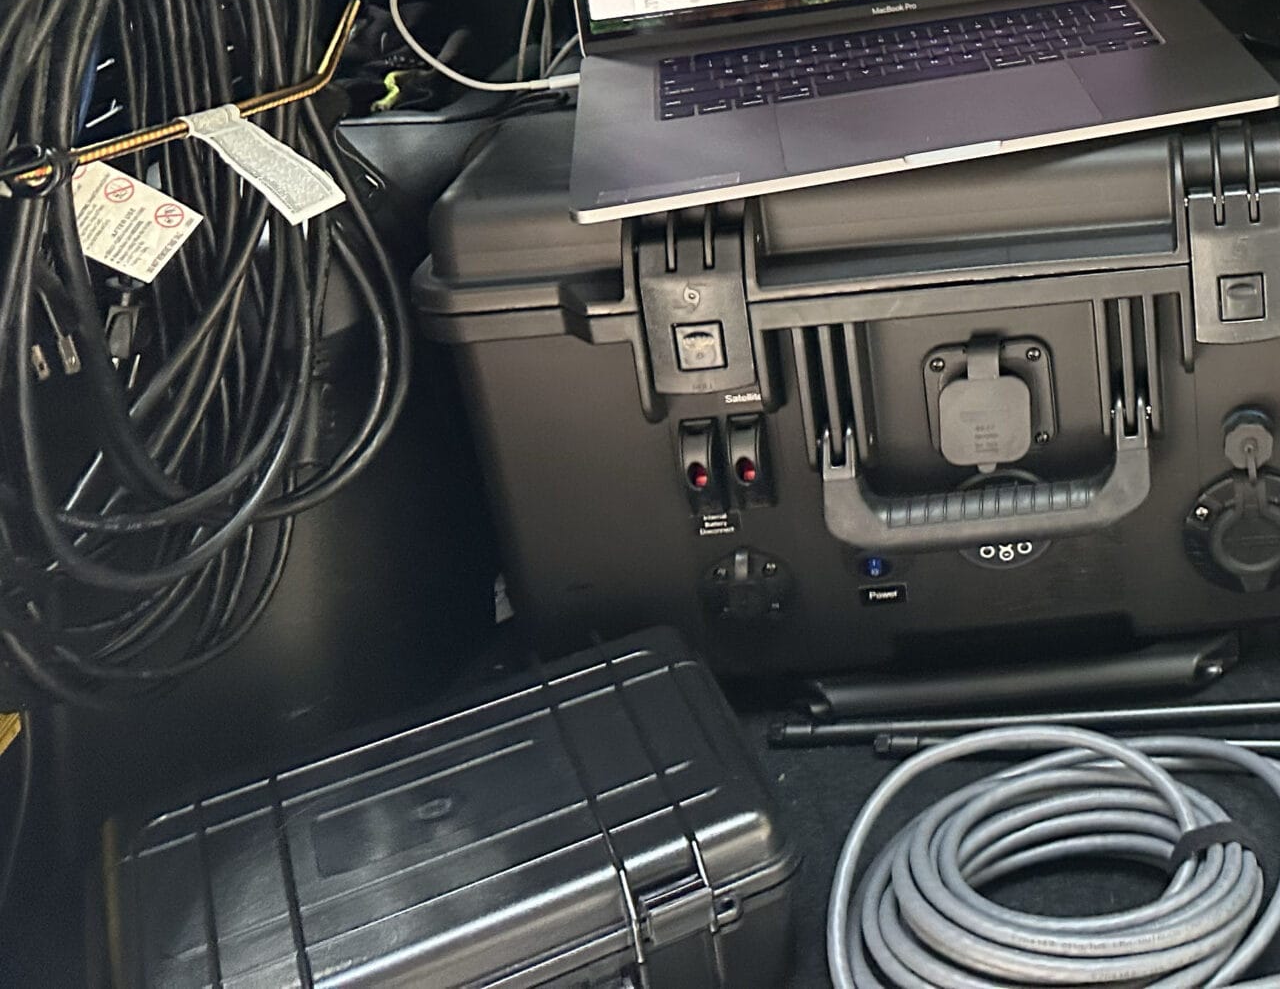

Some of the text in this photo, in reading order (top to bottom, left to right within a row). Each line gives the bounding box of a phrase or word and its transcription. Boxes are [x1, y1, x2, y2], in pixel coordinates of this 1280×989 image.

[871, 2, 917, 15] MacBook Pro
[868, 590, 898, 600] Power
